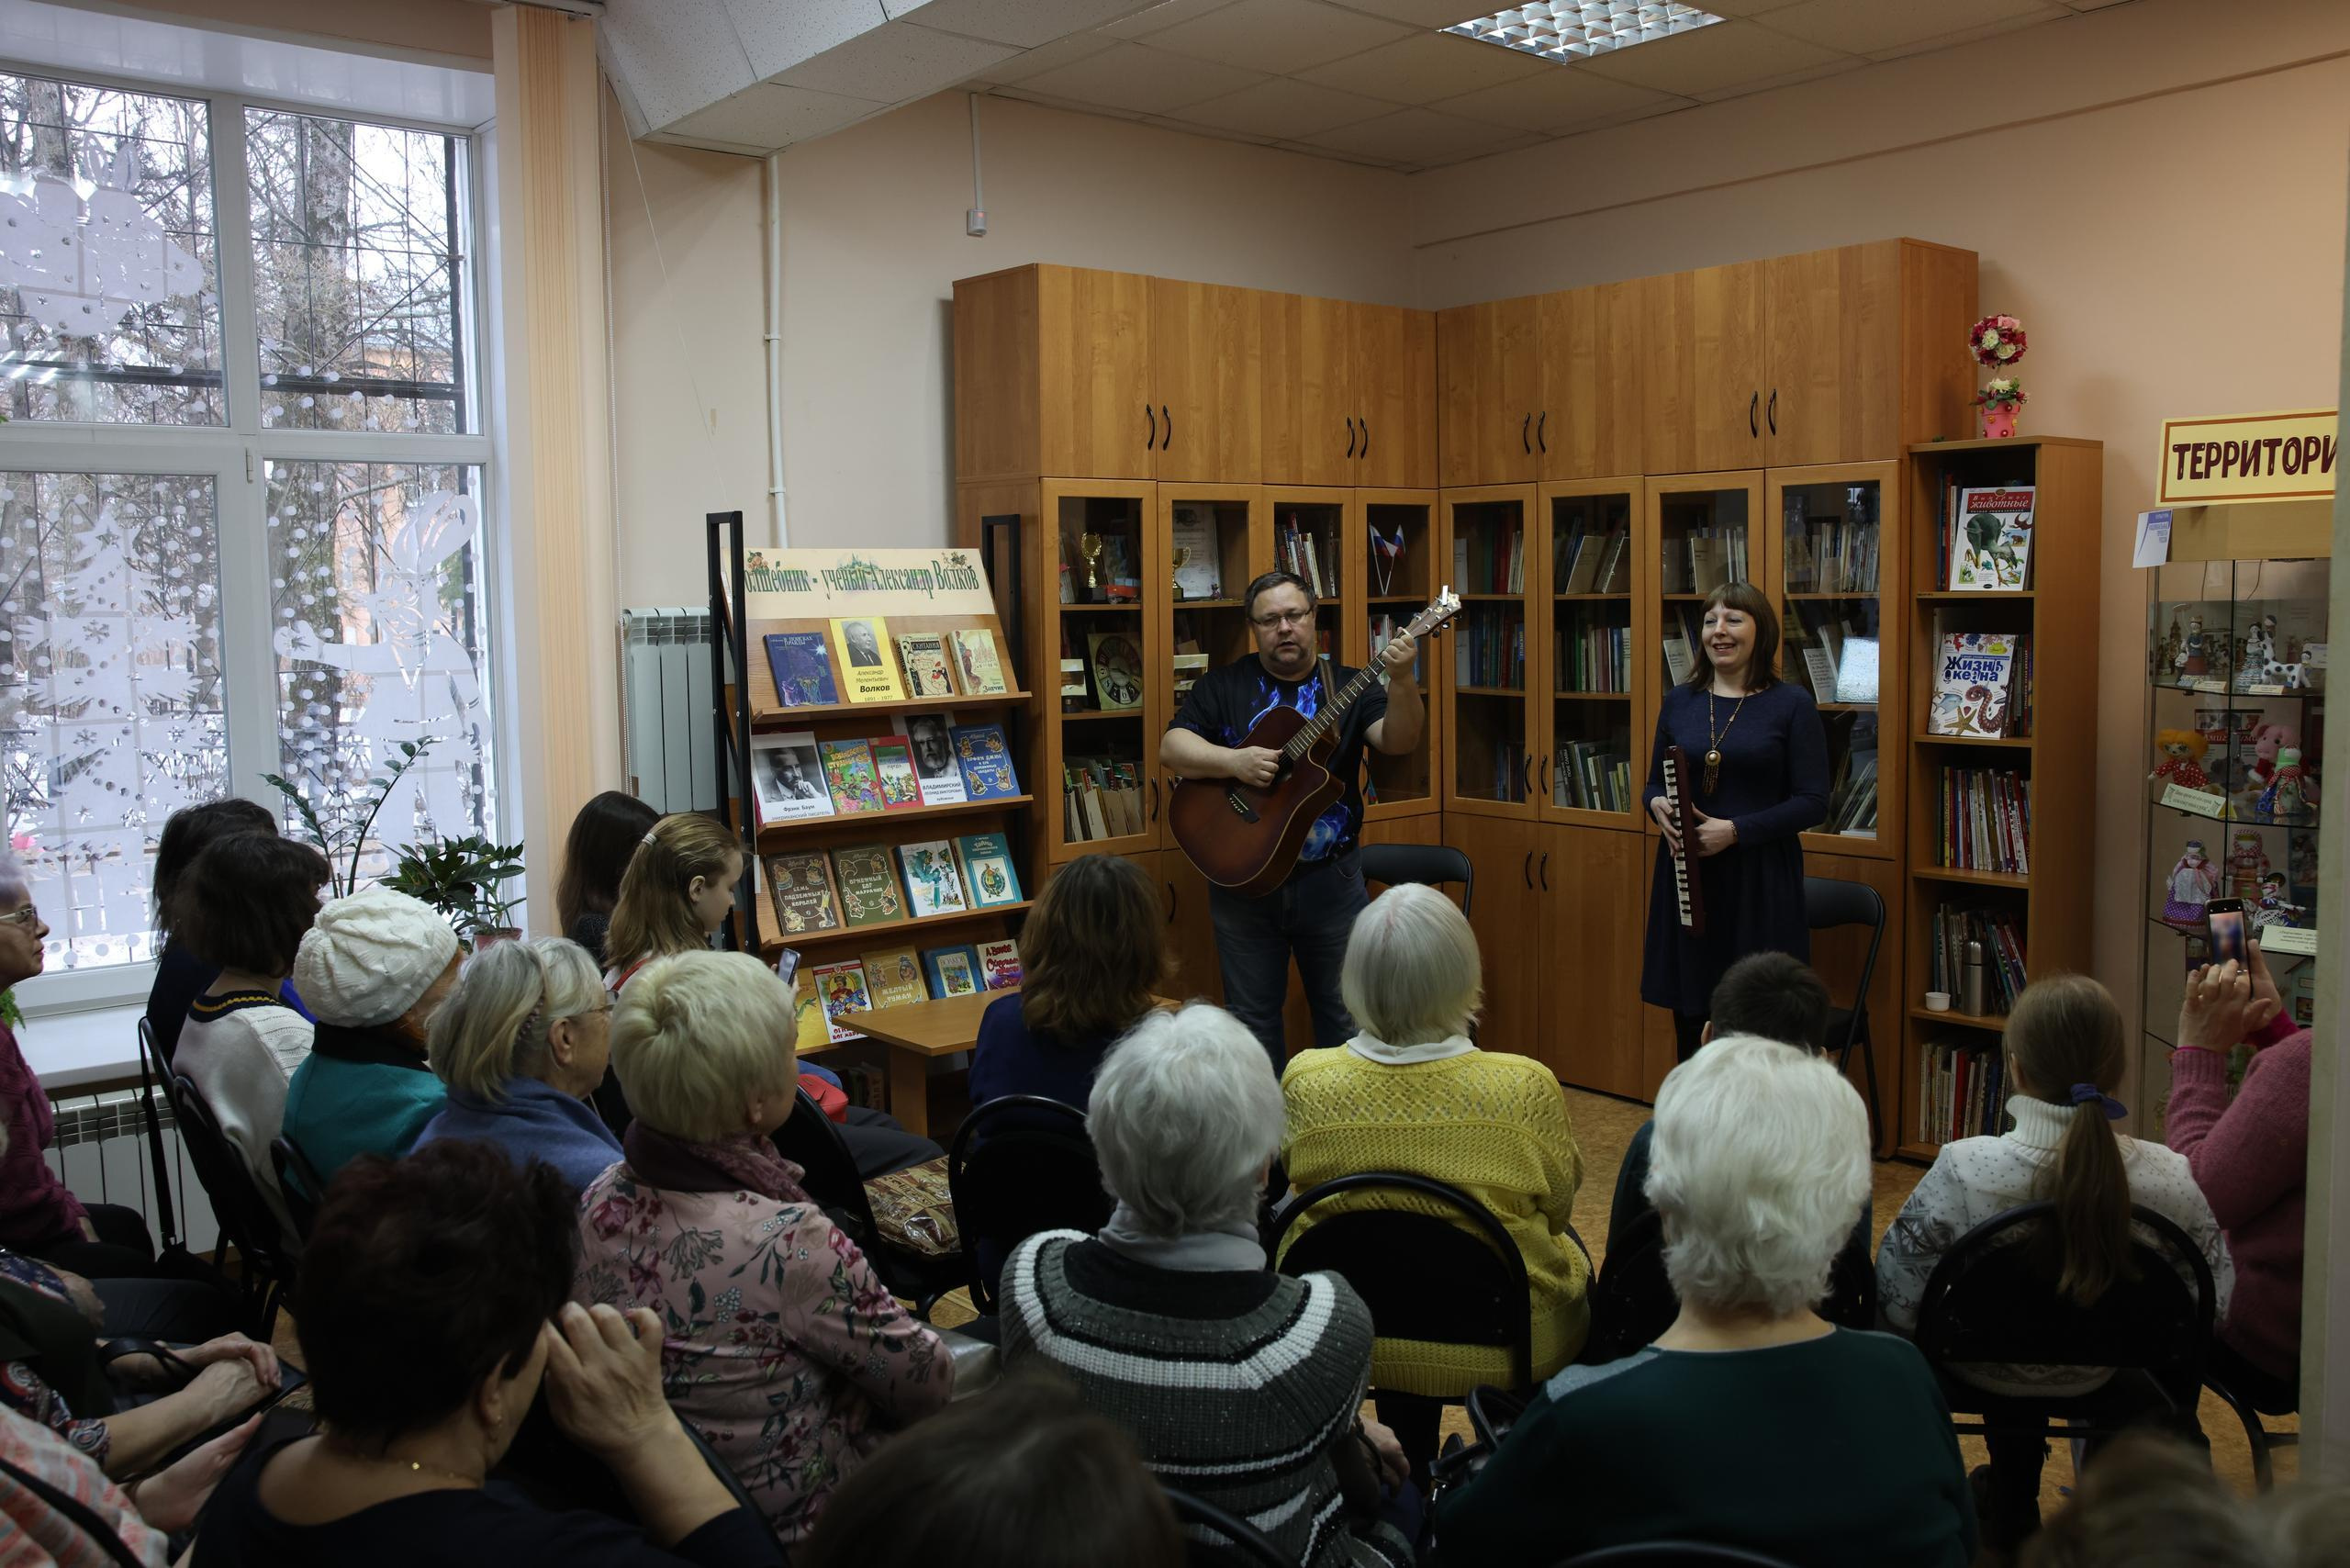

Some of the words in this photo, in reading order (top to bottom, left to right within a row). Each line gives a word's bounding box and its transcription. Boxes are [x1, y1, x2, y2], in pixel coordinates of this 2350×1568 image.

[1970, 499, 2029, 509] животные
[744, 561, 811, 592] олшебник
[870, 561, 934, 599] Александр
[932, 560, 979, 590] Волков
[1945, 655, 2004, 672] Жизнь
[860, 685, 890, 693] Волков
[785, 891, 822, 900] ПОДЗЕМНЫХ
[791, 898, 817, 906] КОРОЛЕЙ
